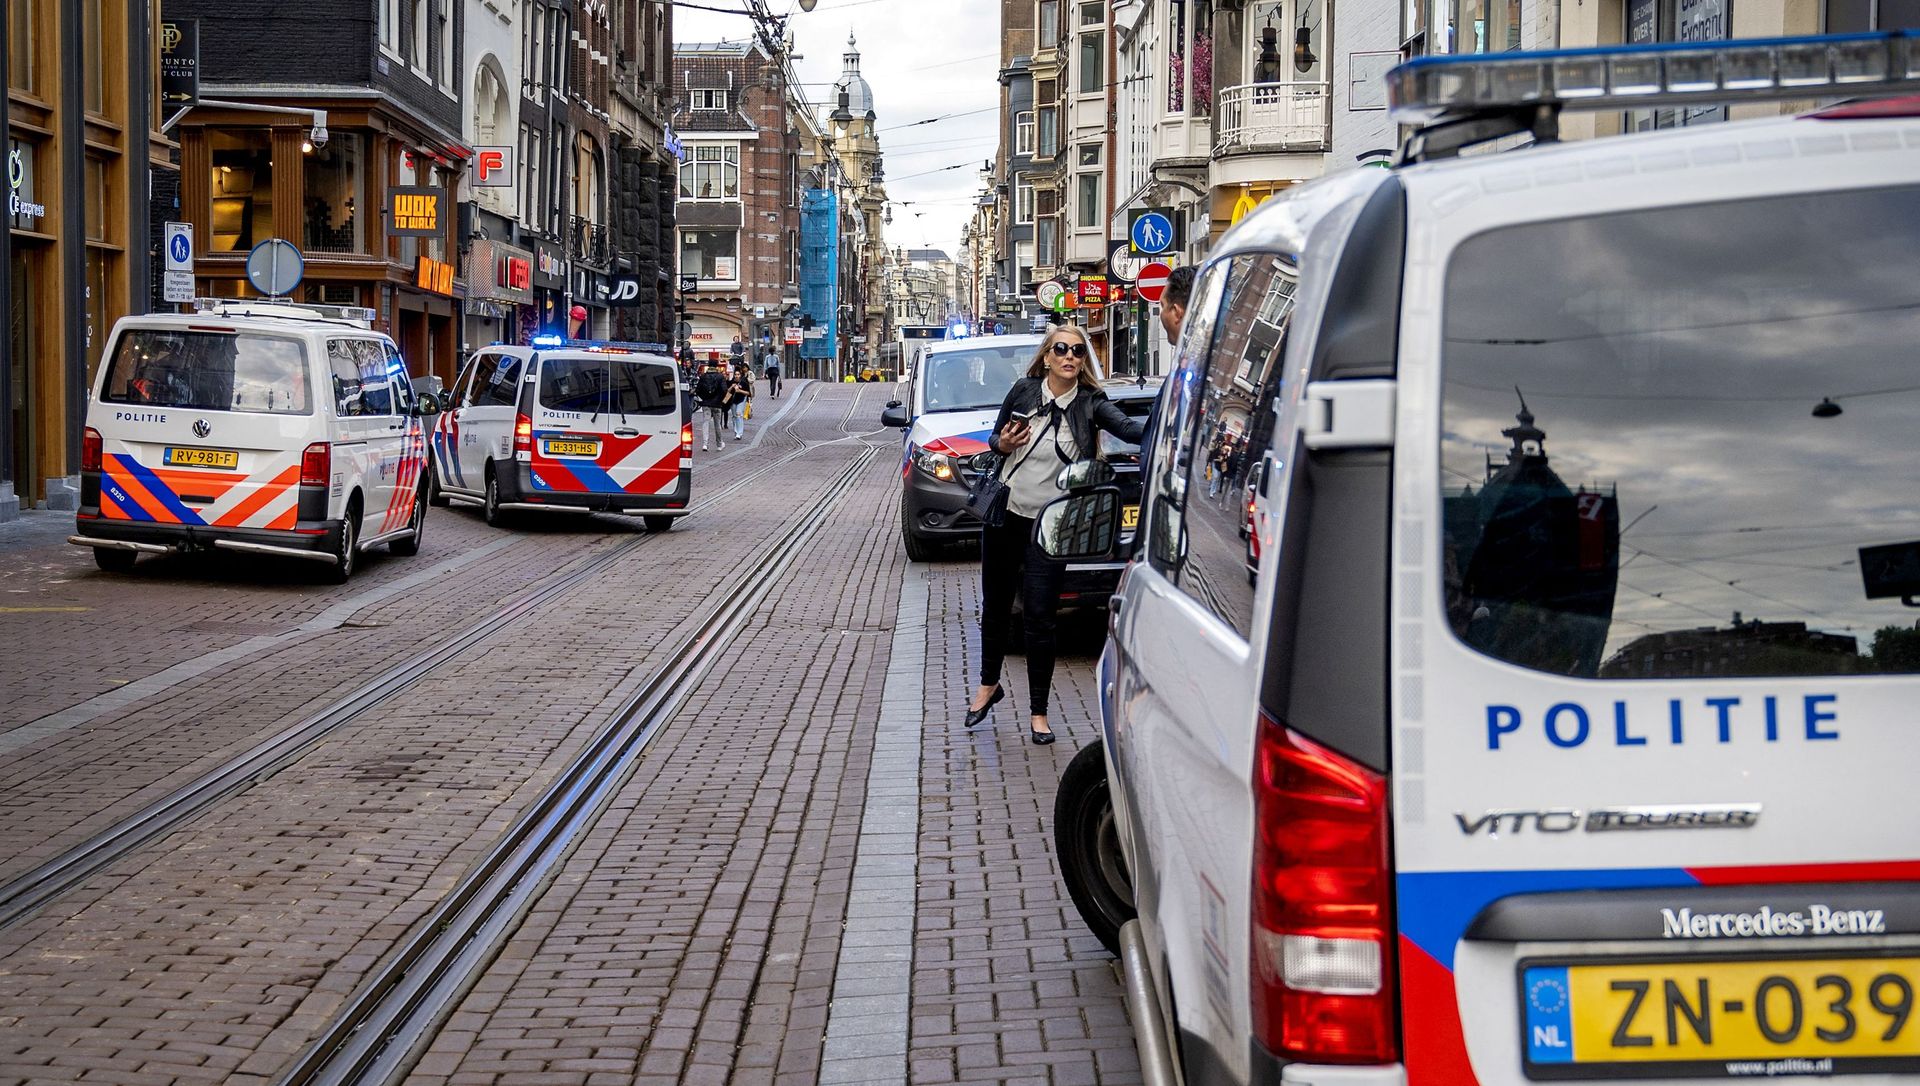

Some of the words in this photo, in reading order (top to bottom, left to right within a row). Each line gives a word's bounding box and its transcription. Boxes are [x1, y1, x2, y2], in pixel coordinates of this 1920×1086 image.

[1634, 22, 1648, 42] OVER
[479, 151, 504, 182] F
[20, 202, 44, 218] express
[394, 195, 437, 217] WOK
[395, 217, 407, 229] TO
[408, 217, 436, 230] WALK
[611, 281, 639, 300] JD
[682, 280, 696, 291] Etos
[1084, 282, 1102, 291] حلال
[116, 412, 167, 423] POLITIE
[543, 411, 581, 420] POLITIE
[553, 443, 592, 452] H-331-HS
[176, 450, 232, 464] RV-981-F
[110, 487, 125, 502] 8320
[1486, 694, 1840, 750] POLITIE
[1454, 810, 1579, 835] VITO
[1590, 807, 1759, 832] TOURER
[1660, 903, 1886, 940] Mercedes-Benz
[1610, 973, 1914, 1047] ZN-039
[1533, 1026, 1567, 1047] NL
[1726, 1058, 1832, 1075] www.politie.nl
